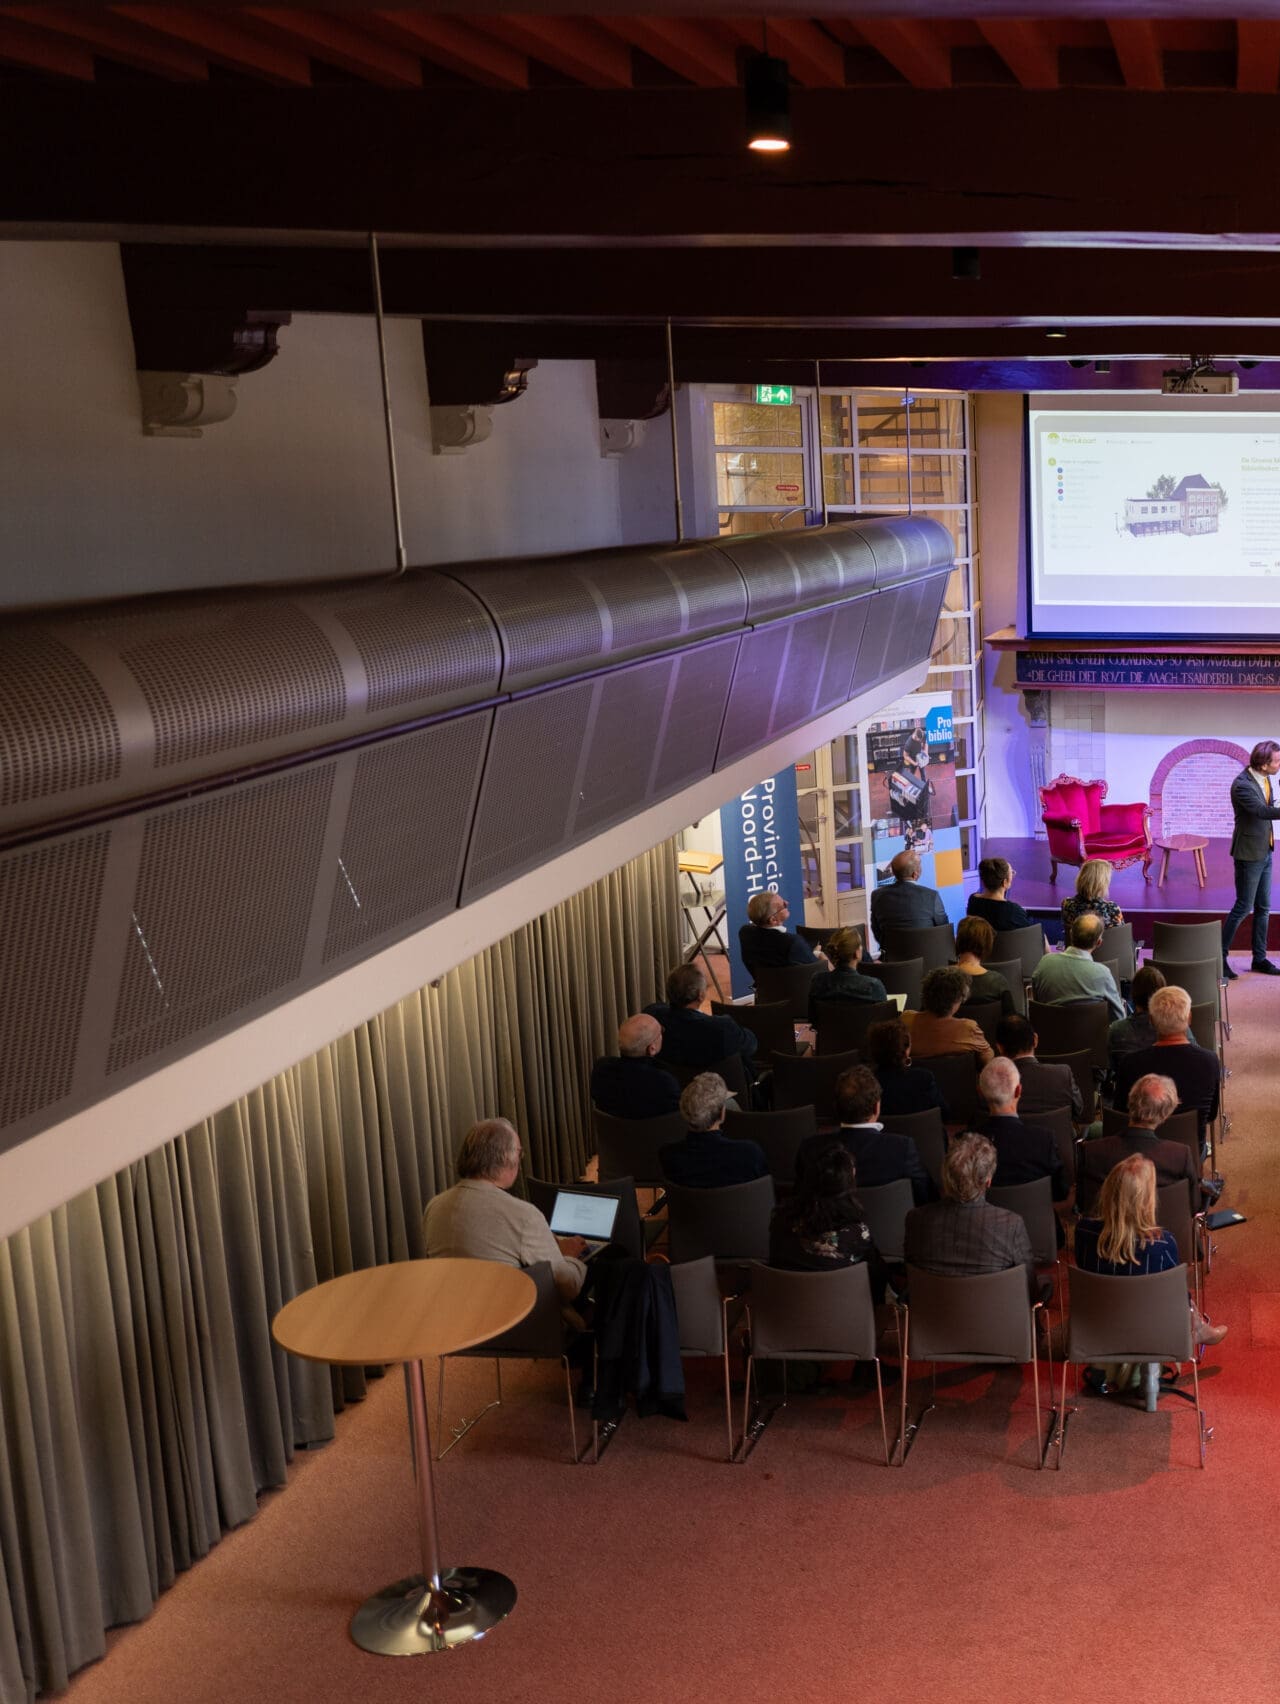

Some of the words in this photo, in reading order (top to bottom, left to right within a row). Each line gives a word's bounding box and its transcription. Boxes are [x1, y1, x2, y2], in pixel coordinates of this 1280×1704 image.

[1048, 669, 1076, 682] GHEEN
[1147, 671, 1178, 684] MACH
[937, 716, 952, 729] Pro
[928, 729, 953, 743] biblio
[760, 778, 783, 894] Provincie
